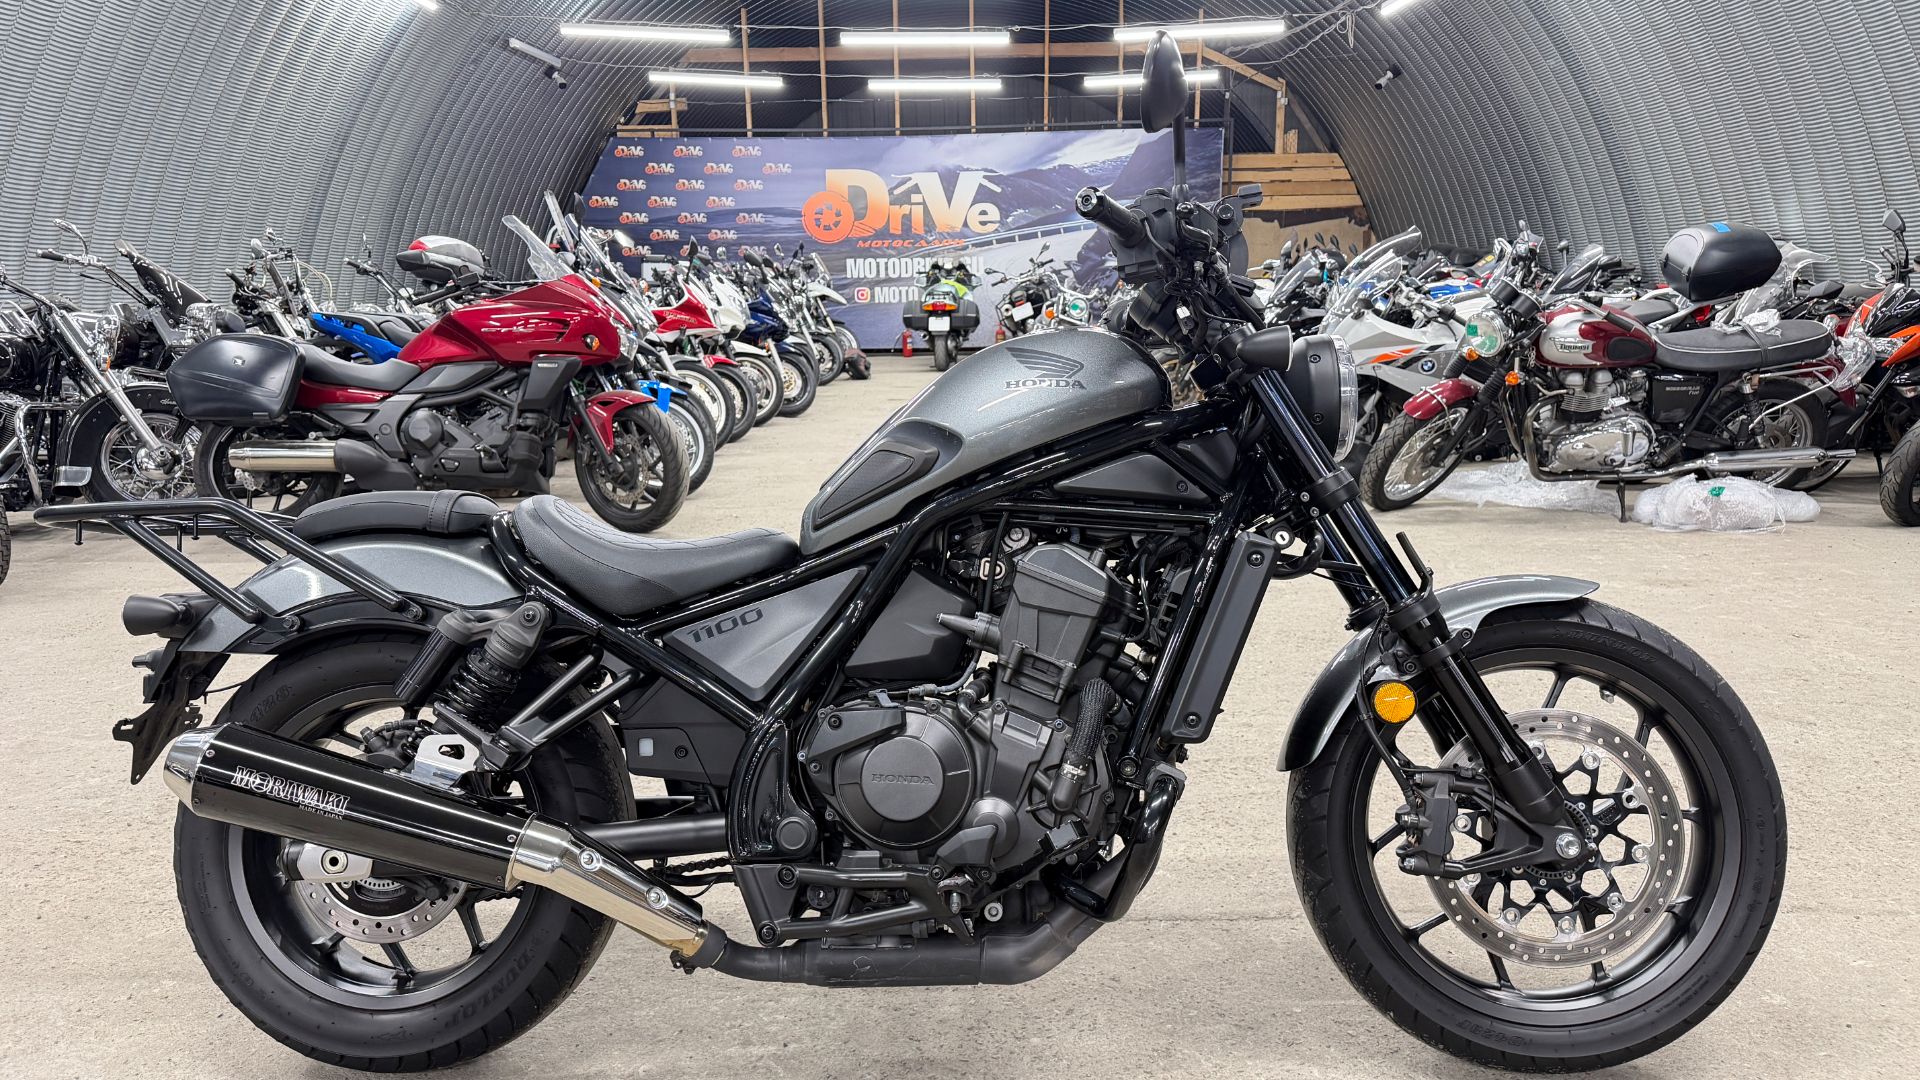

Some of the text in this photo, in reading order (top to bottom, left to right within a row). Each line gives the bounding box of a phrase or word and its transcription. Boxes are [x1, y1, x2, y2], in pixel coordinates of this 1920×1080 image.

[874, 286, 920, 304] MOTO
[1004, 378, 1087, 390] HONDA
[686, 606, 764, 643] 1100
[871, 773, 935, 786] HONDA
[231, 765, 350, 815] MORIWAKI
[299, 804, 316, 813] MADE
[324, 811, 344, 821] JAPAN
